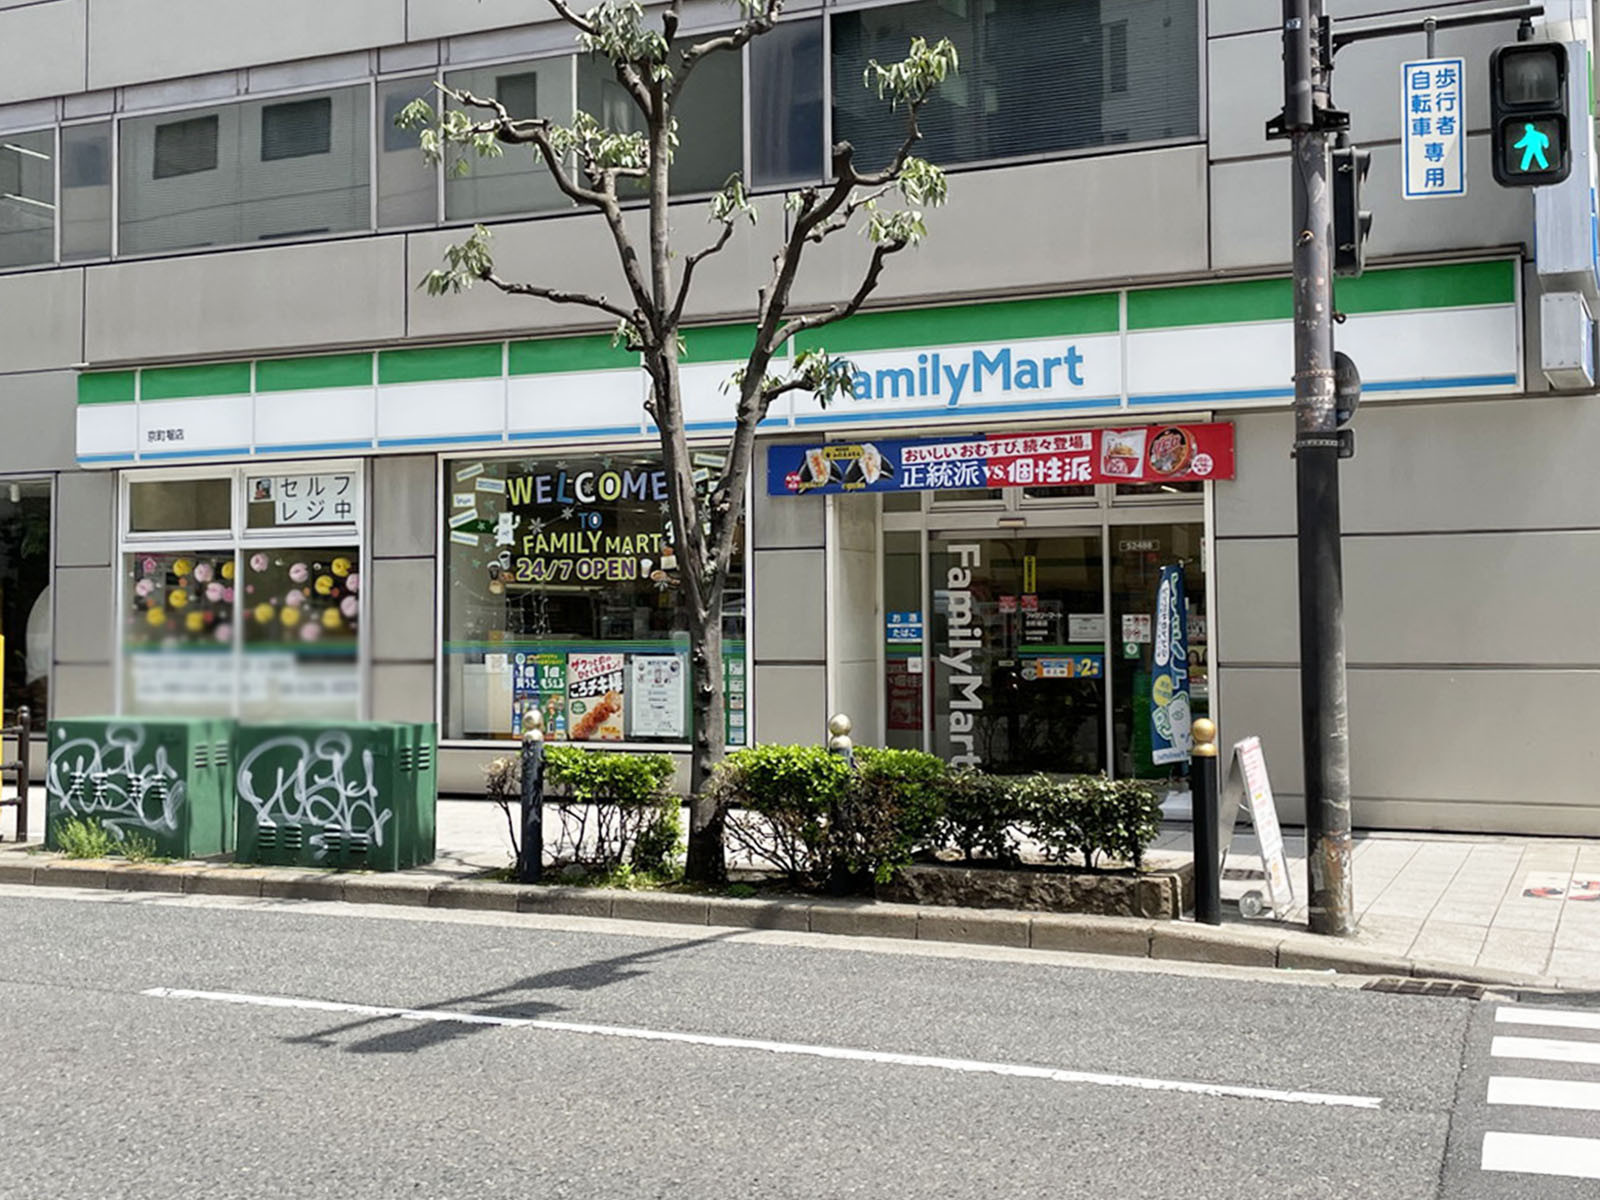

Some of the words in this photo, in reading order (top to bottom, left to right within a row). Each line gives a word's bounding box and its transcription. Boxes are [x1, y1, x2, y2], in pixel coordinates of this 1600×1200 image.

[1411, 70, 1432, 137] 自転車
[1435, 68, 1457, 136] 歩行者
[1424, 142, 1445, 188] 専用
[901, 460, 980, 488] 正統派
[1007, 456, 1093, 483] 個性派
[280, 475, 350, 498] セルフ
[507, 470, 669, 506] WELCOME
[282, 500, 351, 521] レジ中
[578, 512, 603, 530] TO
[523, 530, 603, 555] FAMILY
[605, 533, 662, 554] MART
[516, 558, 573, 581] 24/7
[575, 556, 637, 581] OPEN
[892, 628, 918, 638] たばこ
[939, 543, 984, 772] FamilyMart
